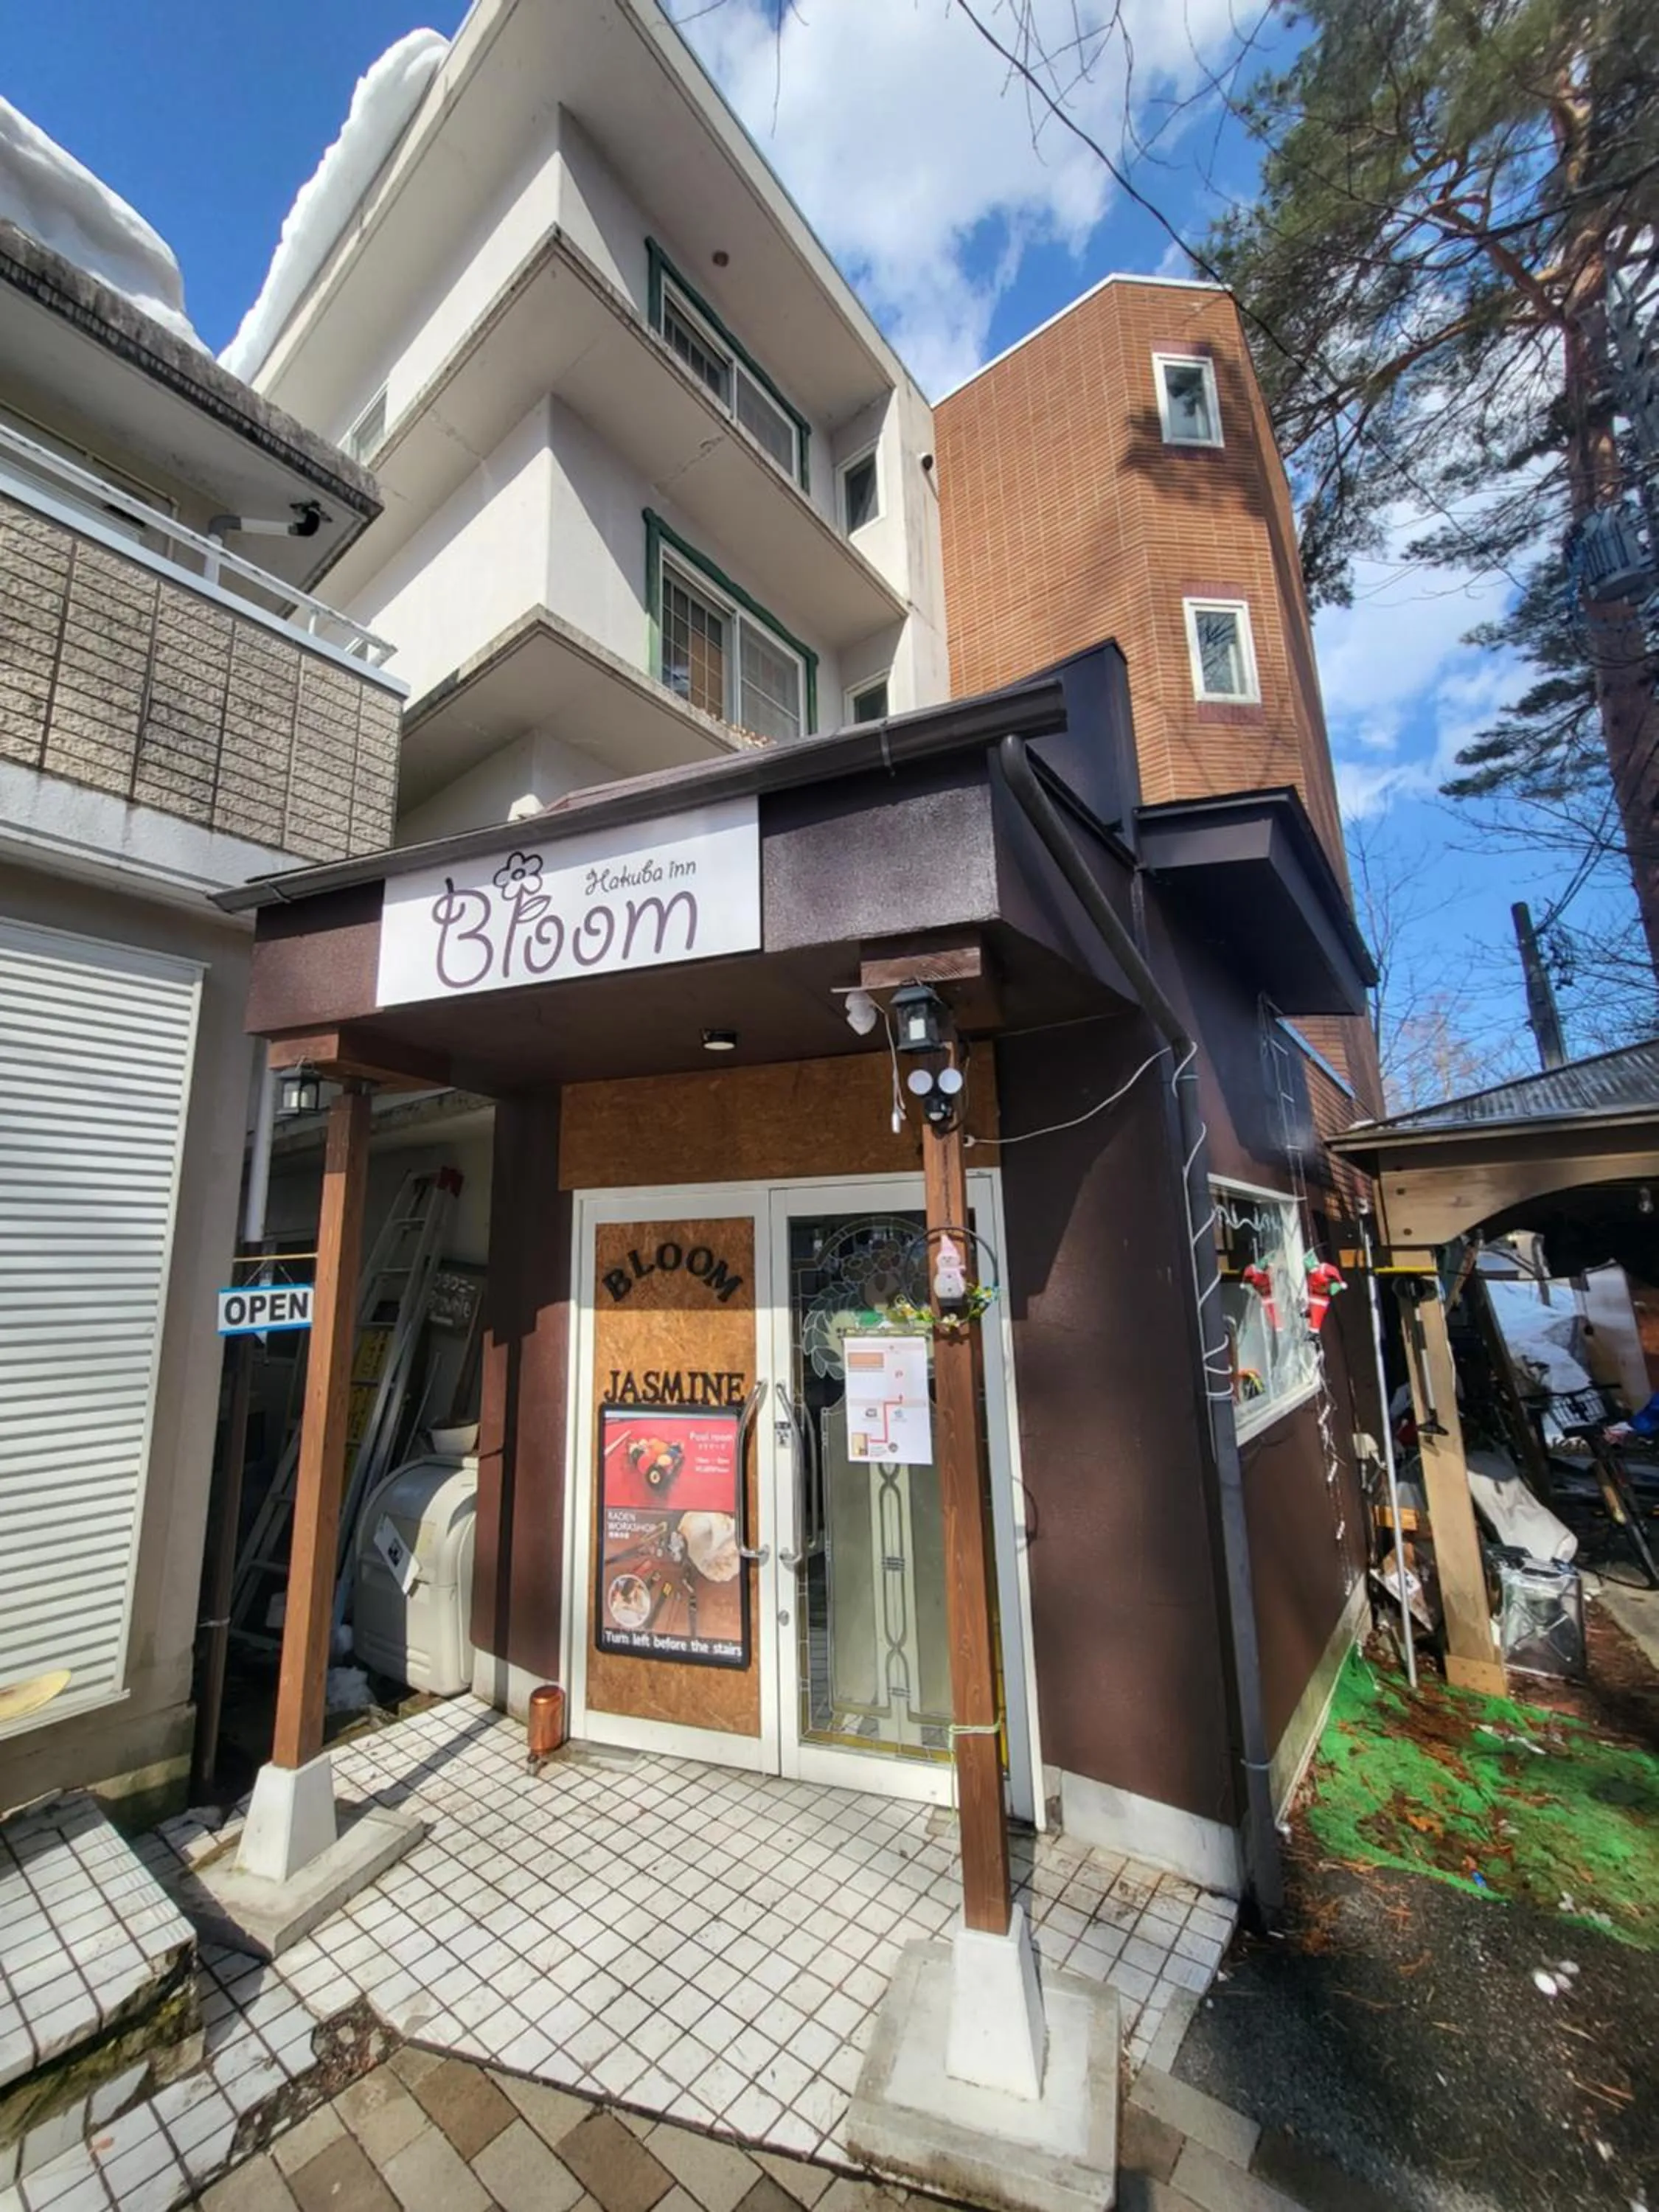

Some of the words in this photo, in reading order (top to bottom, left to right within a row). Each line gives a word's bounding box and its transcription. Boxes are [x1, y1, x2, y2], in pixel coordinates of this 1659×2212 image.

[668, 860, 697, 879] inn
[432, 877, 698, 988] Bloom
[602, 1242, 743, 1303] BLOOM
[224, 1292, 309, 1326] OPEN
[604, 1369, 745, 1406] JASMINE
[605, 1630, 630, 1645] Turn
[633, 1633, 650, 1647] left
[653, 1636, 687, 1653] before
[690, 1641, 709, 1653] the
[712, 1644, 742, 1658] stairs
